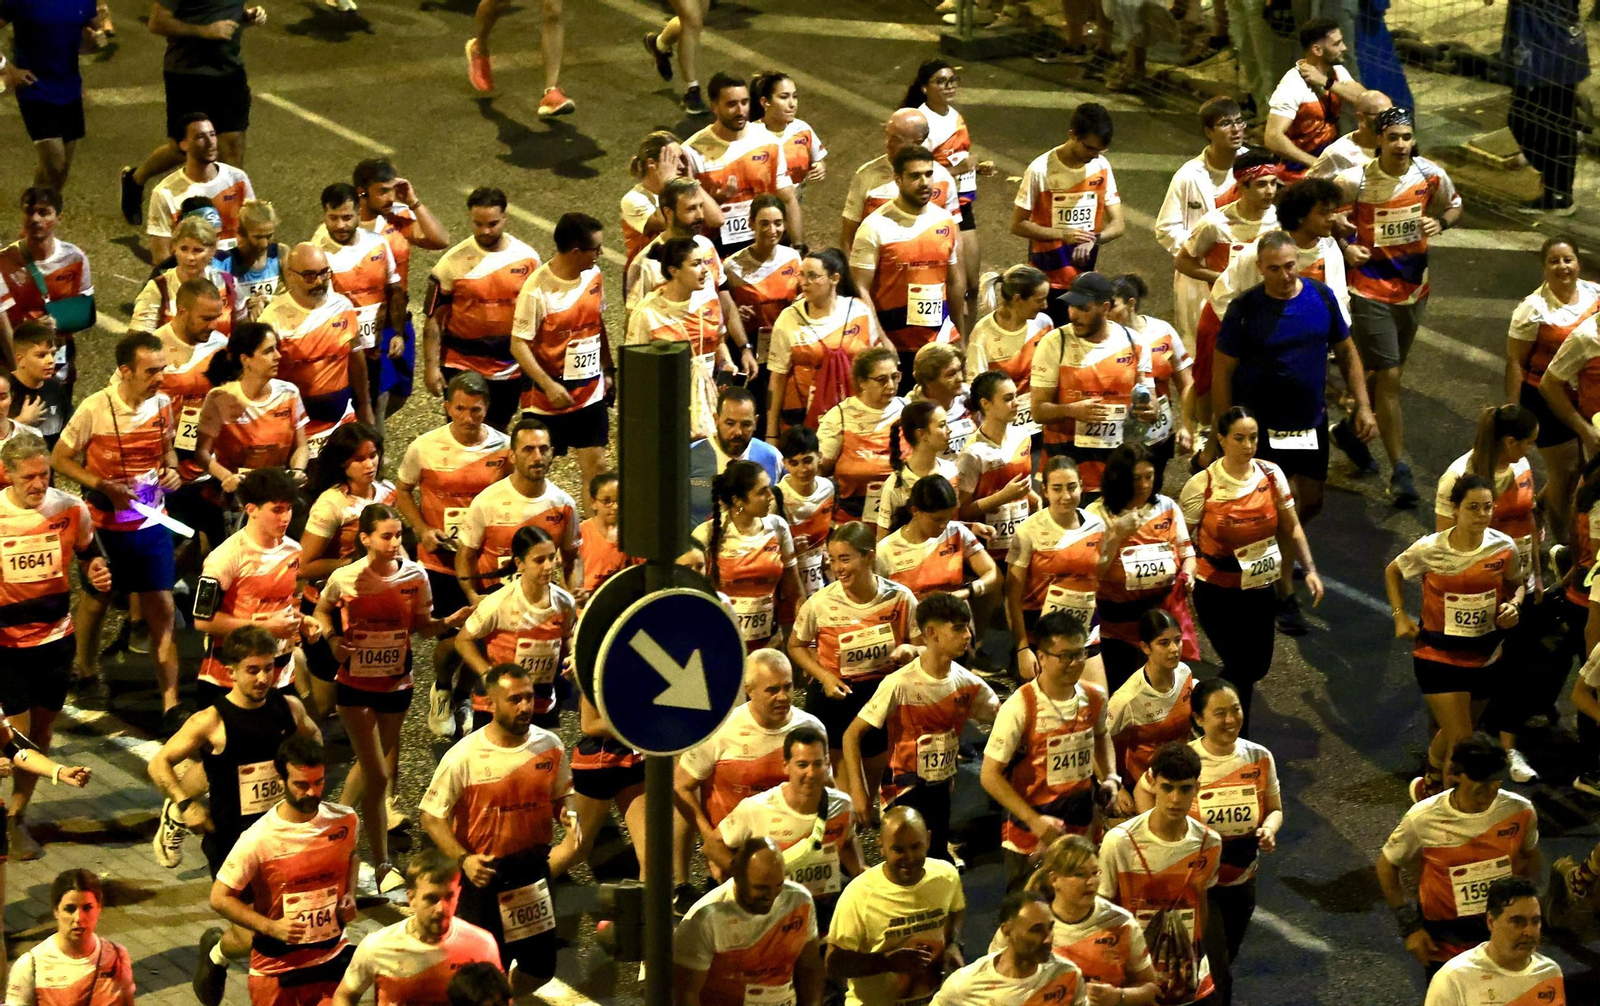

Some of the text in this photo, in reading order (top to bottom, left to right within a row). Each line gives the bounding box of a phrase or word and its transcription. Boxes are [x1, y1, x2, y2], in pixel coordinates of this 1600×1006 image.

[1057, 207, 1092, 222] 10853
[1380, 220, 1417, 236] 16196
[574, 352, 598, 369] 3275
[1085, 423, 1117, 437] 2272
[9, 552, 54, 571] 16641
[1135, 561, 1167, 579] 2294
[1250, 556, 1276, 577] 2280
[1454, 610, 1488, 626] 6252
[357, 649, 400, 664] 10469
[846, 643, 889, 663] 20401
[1052, 750, 1091, 772] 24150
[1206, 805, 1252, 826] 24162
[508, 902, 549, 926] 16035
